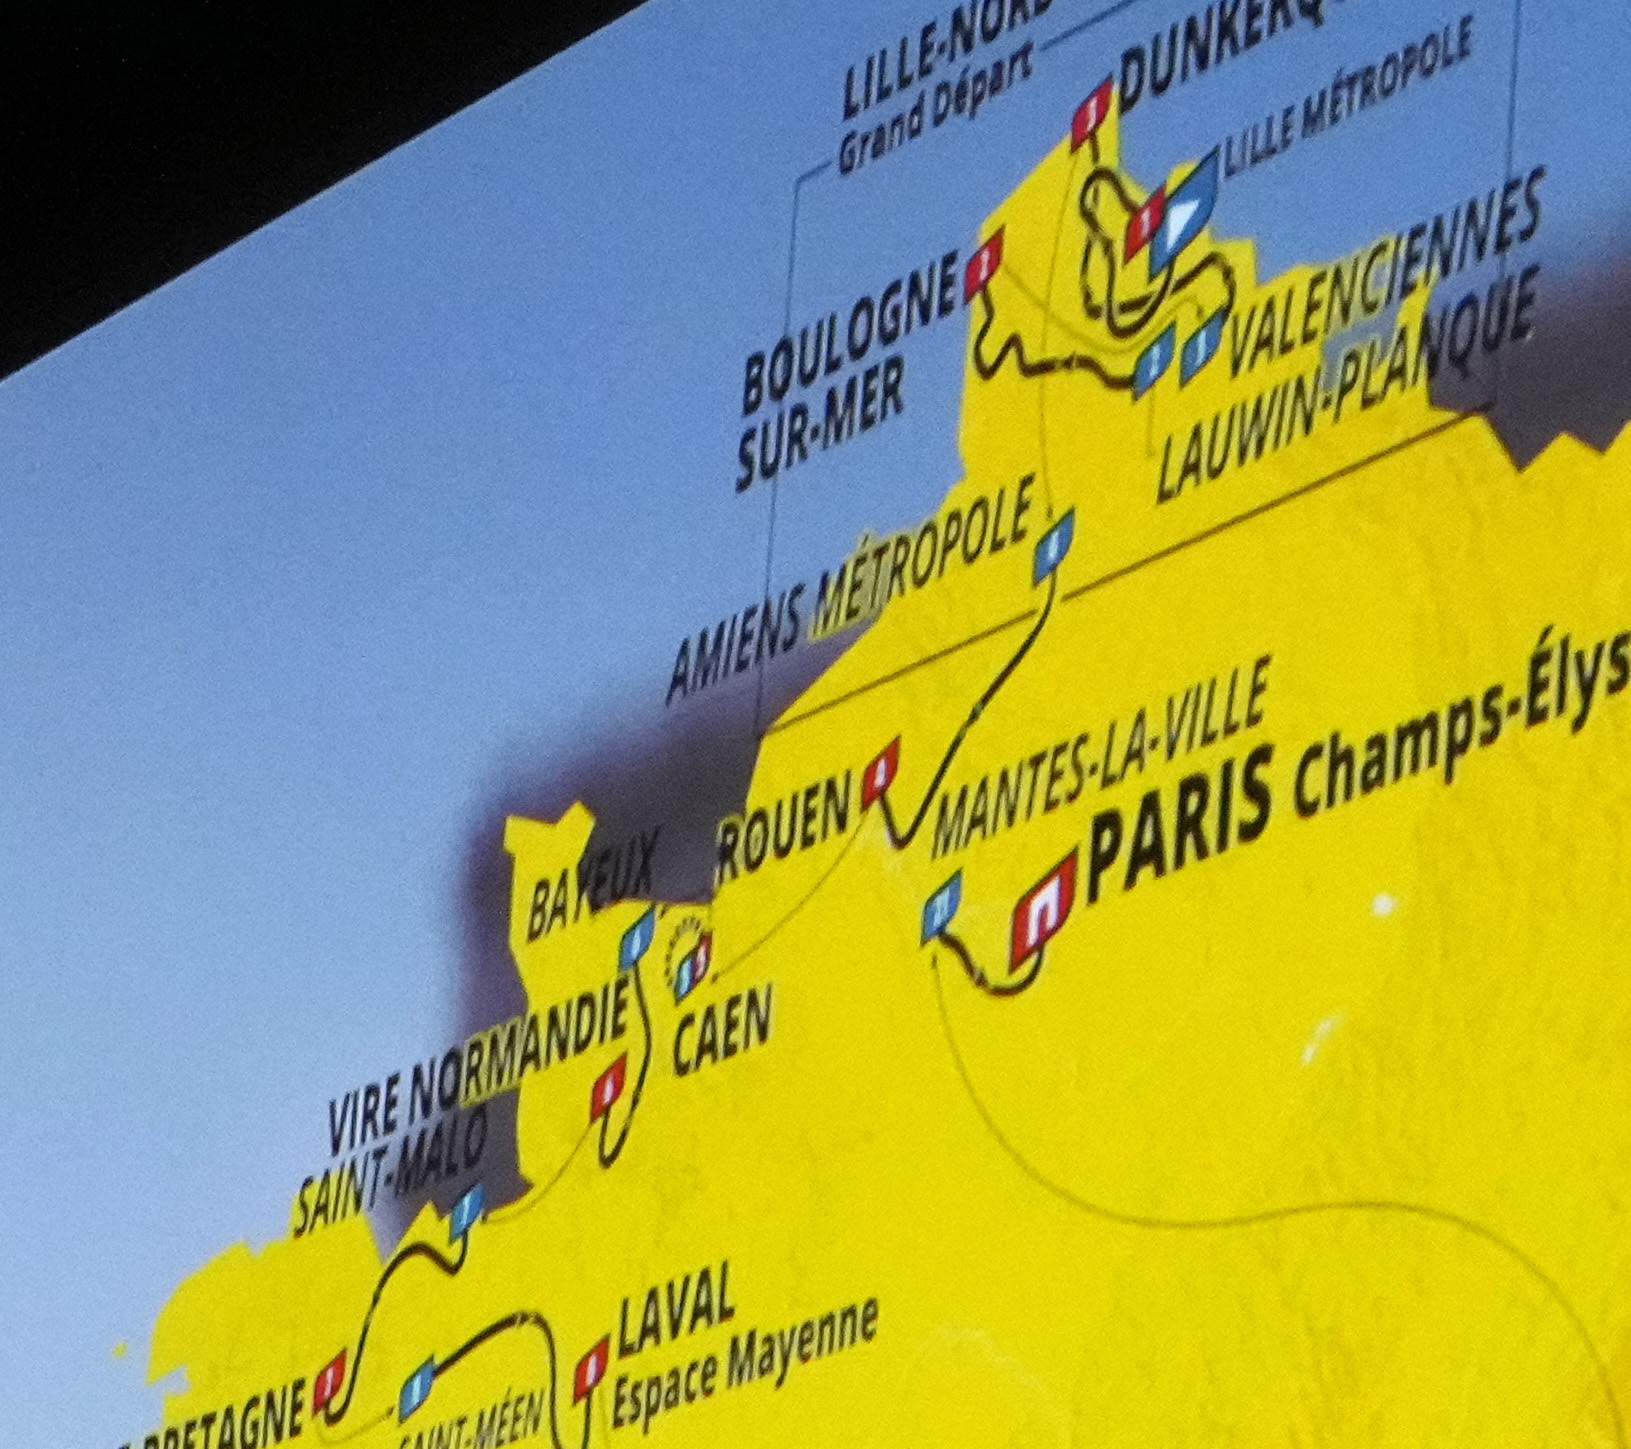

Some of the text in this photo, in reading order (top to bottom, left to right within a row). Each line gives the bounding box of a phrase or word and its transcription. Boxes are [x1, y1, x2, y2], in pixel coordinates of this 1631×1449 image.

[839, 90, 925, 175] Grand
[932, 40, 1034, 128] Départ
[1224, 14, 1474, 181] LILLE MÉTROPOLE
[741, 249, 960, 419] BOULOGNE
[1230, 165, 1547, 379] VALENCIENNES
[734, 355, 905, 493] SUR-MER
[1156, 264, 1542, 504] LAUWIN-PLANQUE
[665, 472, 1036, 708] AMIENS MÉTROPOLE
[715, 769, 853, 885] ROUEN
[930, 653, 1273, 861] MANTES-LA-VILLE
[1085, 742, 1275, 907] PARIS
[525, 827, 662, 943] BAYEUX
[328, 976, 632, 1158] VIRE NORMANDIE
[673, 983, 775, 1077] CAEN
[293, 1107, 490, 1238] SAINT-MALO
[610, 1360, 717, 1436] Espace
[725, 1296, 881, 1391] Mayenne
[616, 1259, 736, 1359] LAVAL
